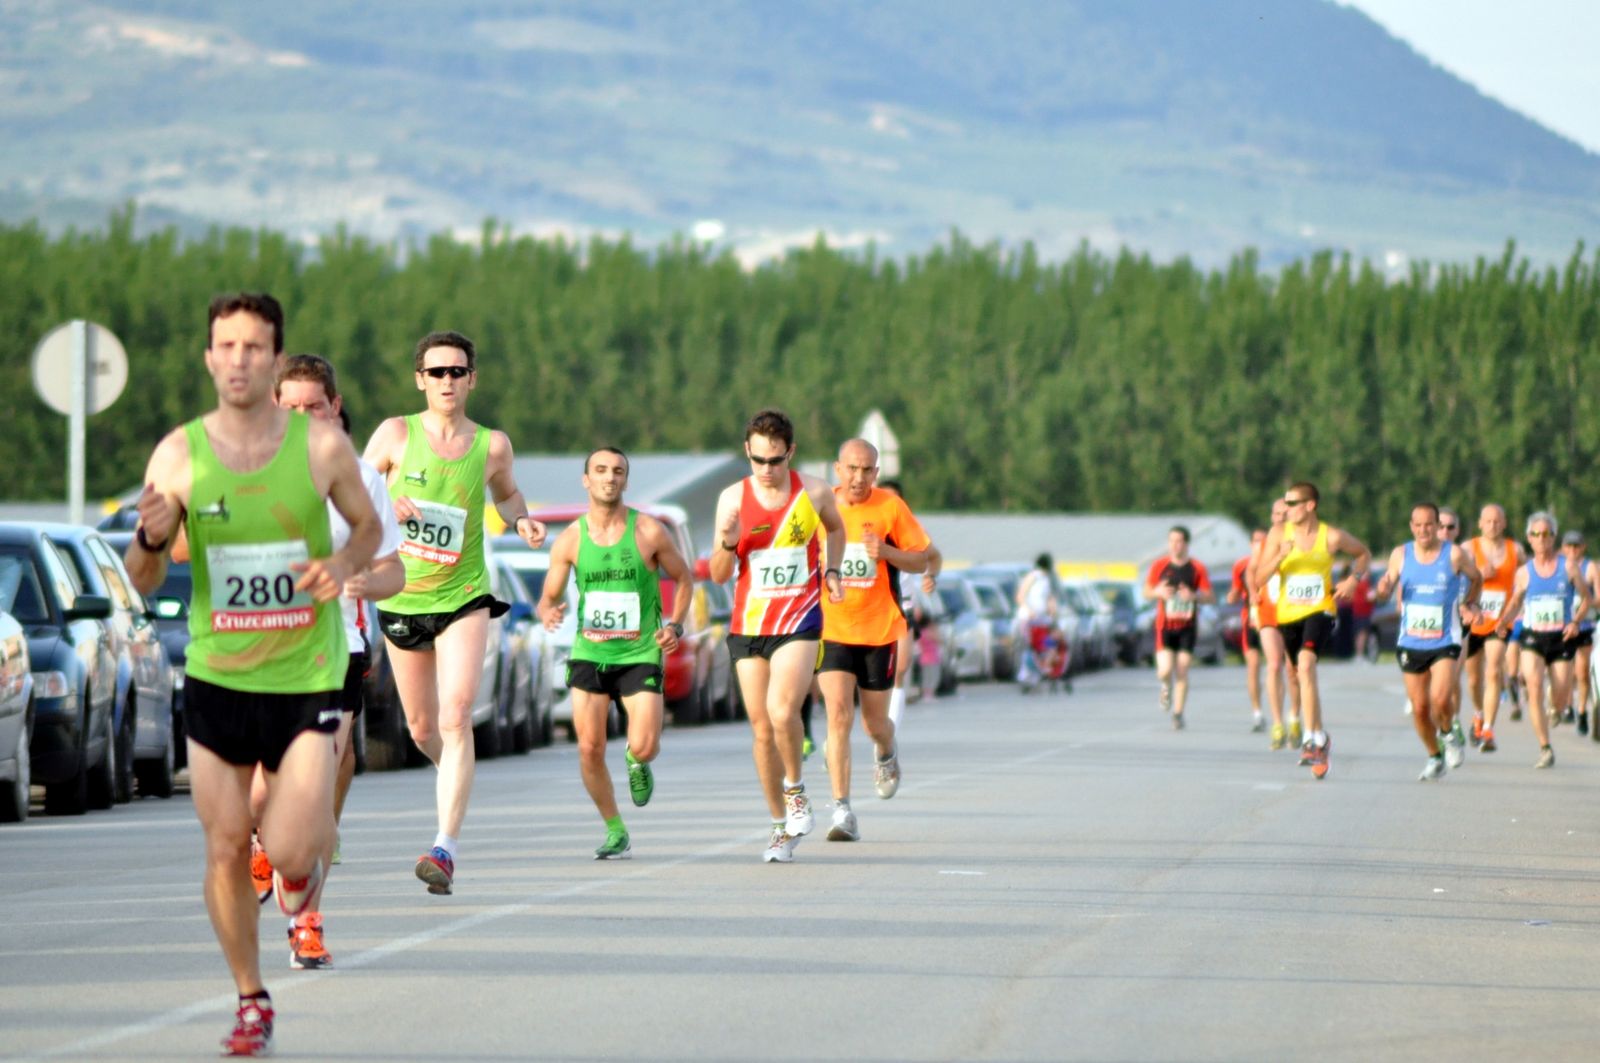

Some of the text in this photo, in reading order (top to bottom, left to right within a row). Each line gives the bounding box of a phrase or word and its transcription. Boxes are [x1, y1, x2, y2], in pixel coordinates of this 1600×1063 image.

[406, 519, 452, 548] 950
[760, 564, 798, 586] 767
[226, 573, 295, 607] 280
[1288, 584, 1321, 598] 2087
[213, 608, 310, 632] Cruzcampo
[591, 609, 627, 630] 851
[1412, 616, 1436, 630] 242
